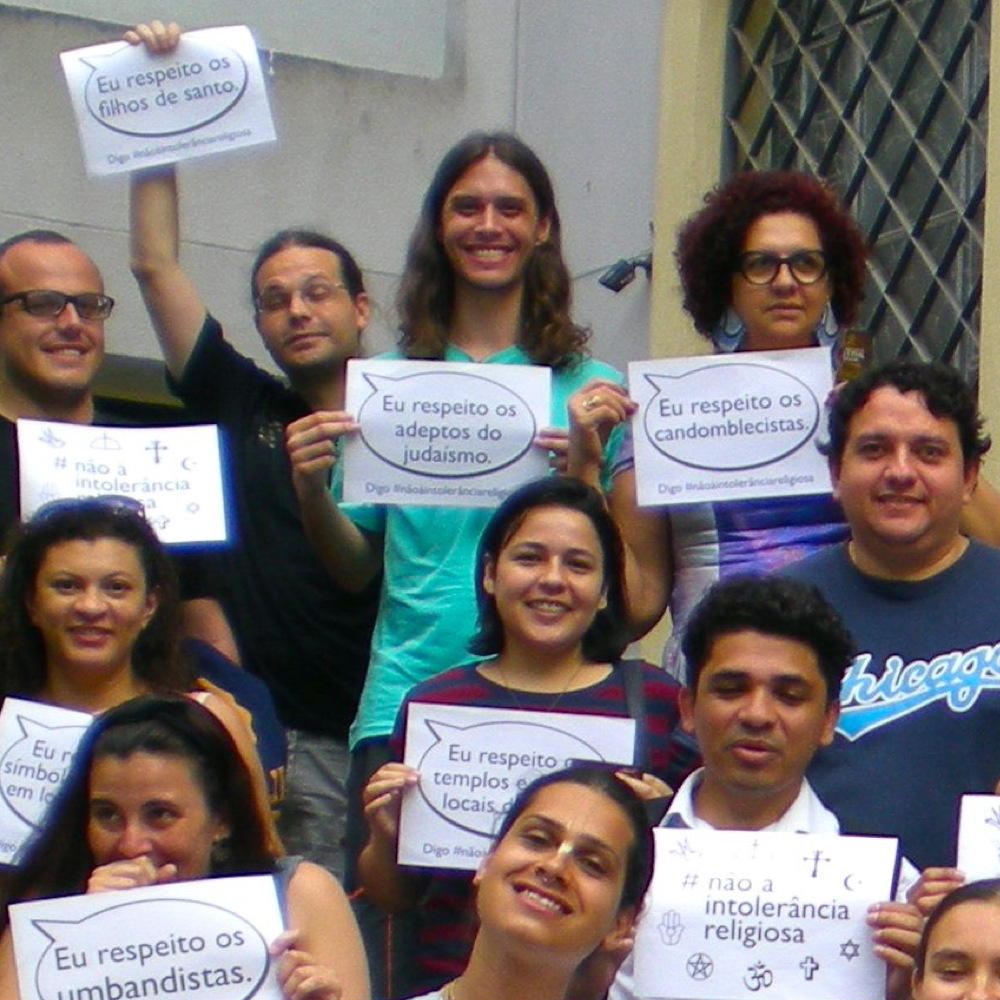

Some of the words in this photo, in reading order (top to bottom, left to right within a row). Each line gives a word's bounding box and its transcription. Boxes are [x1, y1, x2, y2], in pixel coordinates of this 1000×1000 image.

[97, 76, 120, 94] Eu
[127, 62, 202, 88] respeito
[208, 56, 231, 72] os
[98, 96, 149, 119] filhos
[155, 89, 178, 107] de
[184, 79, 239, 101] santo.
[383, 395, 404, 412] Eu
[413, 397, 489, 418] respeito
[495, 404, 516, 418] os
[659, 399, 683, 417] Eu
[691, 393, 772, 418] respeito
[779, 393, 802, 408] os
[395, 421, 470, 442] adeptos
[477, 423, 502, 441] do
[654, 417, 810, 443] candomblecistas.
[403, 445, 492, 466] judaísmo.
[365, 482, 390, 496] Digo
[658, 482, 683, 496] Digo
[32, 739, 55, 761] Eu
[449, 743, 471, 762] Eu
[479, 750, 557, 771] respeito
[6, 783, 33, 800] em
[434, 771, 509, 792] templos
[443, 792, 494, 814] locais
[422, 843, 451, 858] Digo
[704, 895, 851, 921] intolerância
[704, 918, 806, 949] religiosa
[54, 945, 87, 971] Eu
[98, 932, 206, 967] respeito
[215, 929, 245, 949] os
